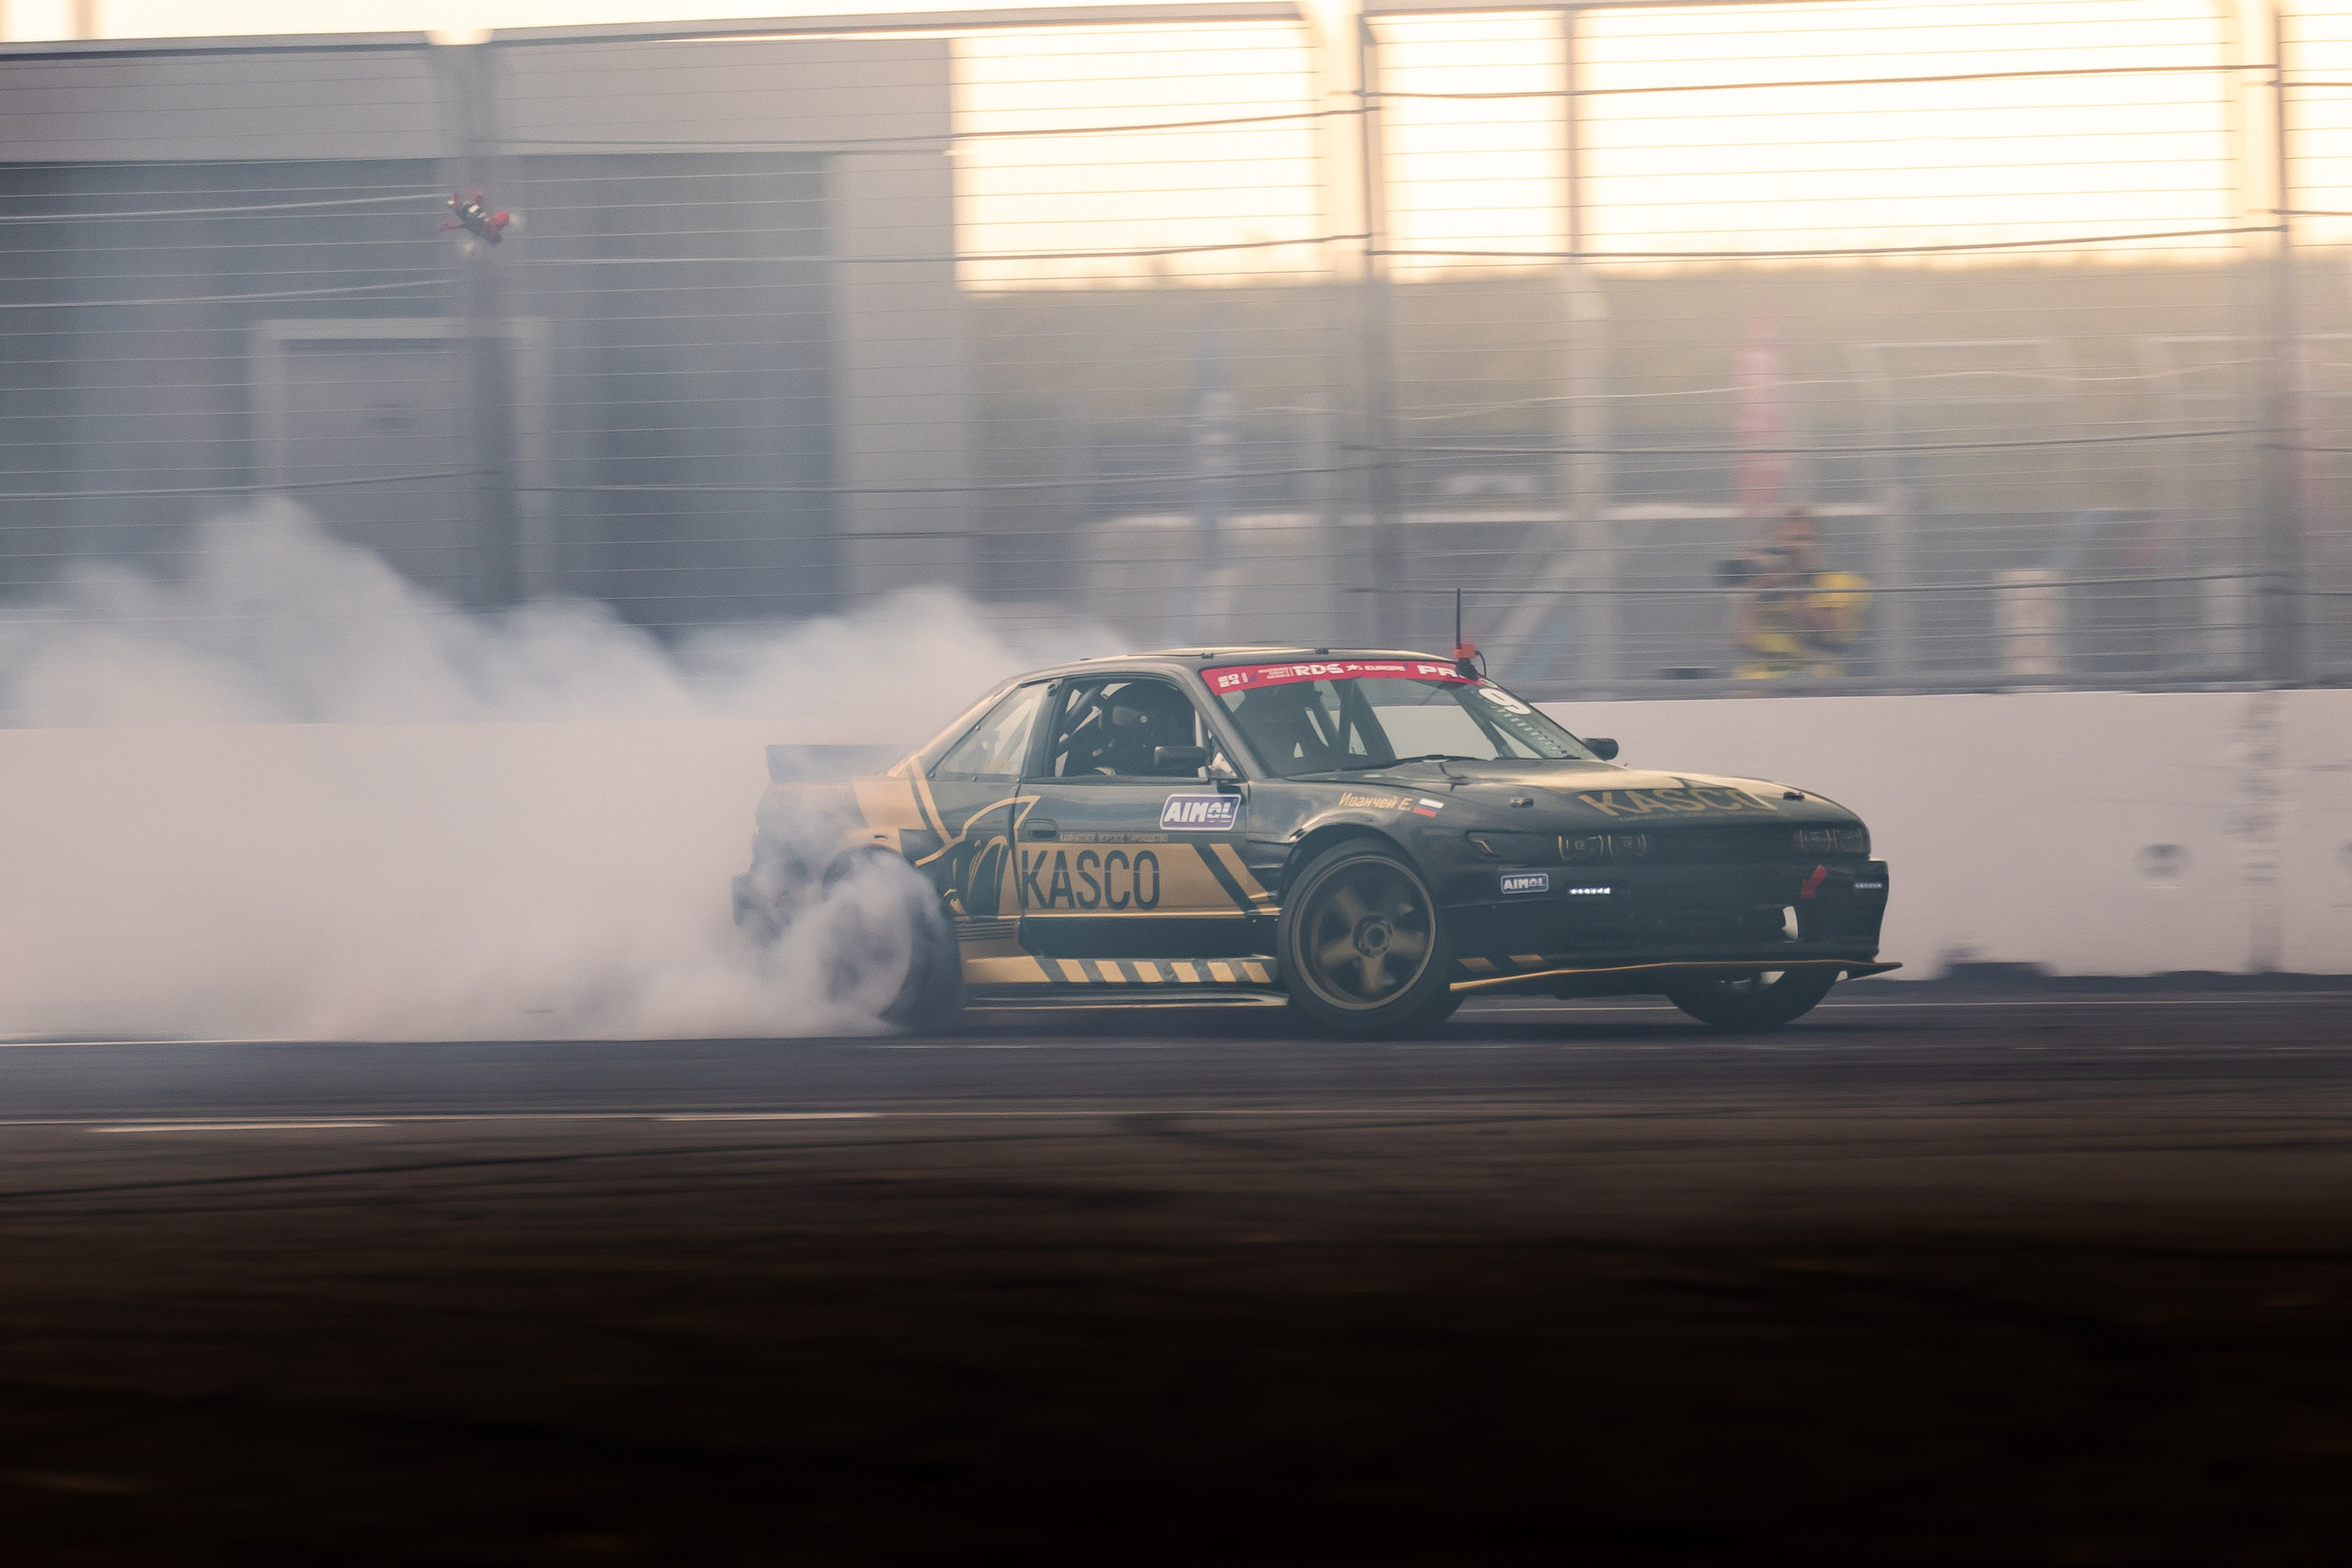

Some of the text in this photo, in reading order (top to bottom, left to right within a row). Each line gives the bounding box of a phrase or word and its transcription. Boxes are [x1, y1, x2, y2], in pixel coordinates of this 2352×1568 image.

[1292, 663, 1344, 676] RDS
[1417, 665, 1468, 679] PR
[1478, 687, 1532, 715] 9
[1339, 792, 1399, 809] Иванчей
[1163, 801, 1232, 823] AIMOL
[1022, 850, 1160, 910] KASCO
